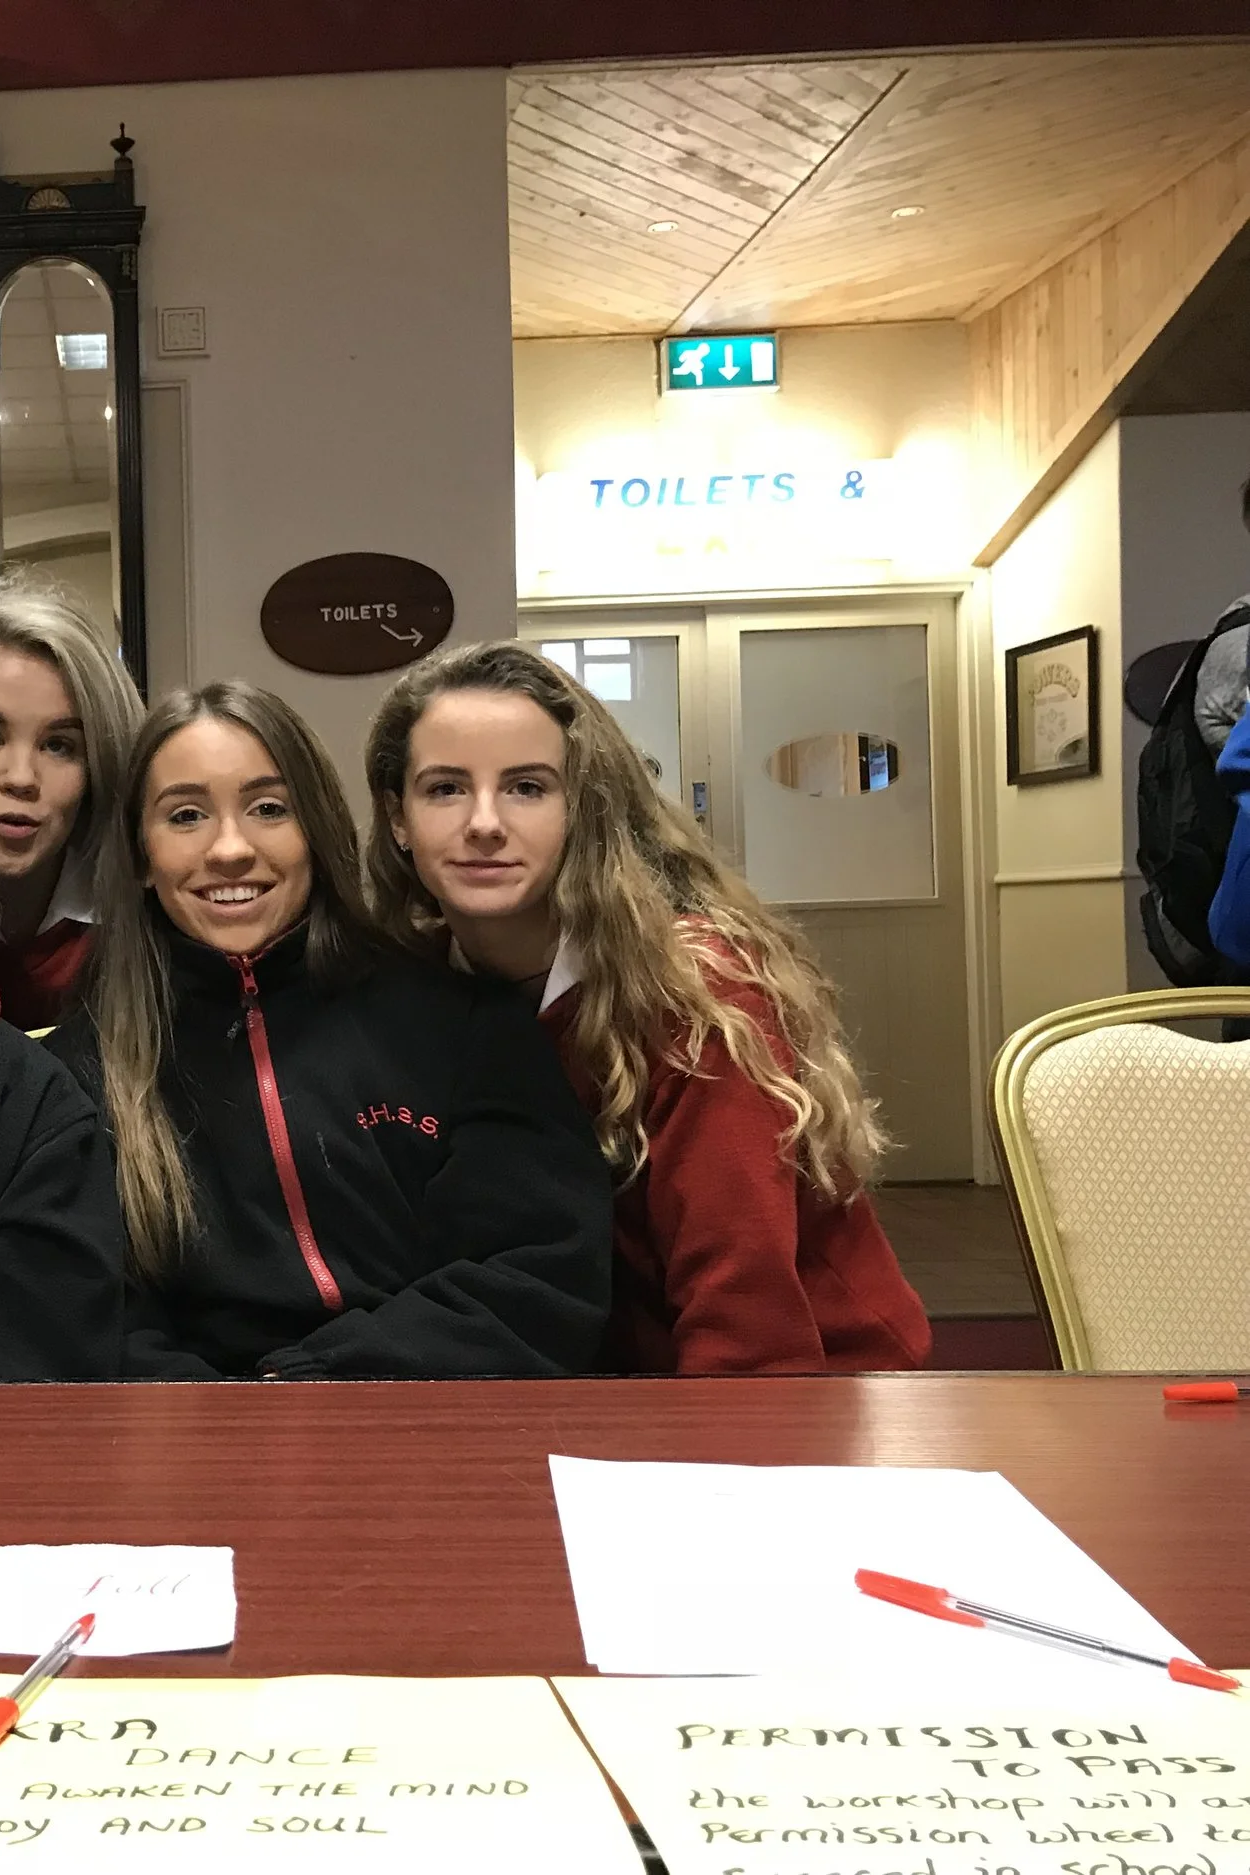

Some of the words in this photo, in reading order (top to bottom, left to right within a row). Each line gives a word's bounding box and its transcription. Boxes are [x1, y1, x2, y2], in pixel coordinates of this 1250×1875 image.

[590, 472, 796, 508] TOILETS
[839, 470, 866, 500] &
[320, 603, 398, 622] TOILETS
[675, 1723, 1149, 1750] PERMISSION
[125, 1746, 379, 1767] DANCE
[951, 1757, 1041, 1778] TO
[1064, 1755, 1237, 1777] PASS
[19, 1781, 233, 1800] AWAKEN
[258, 1781, 359, 1797] THE
[388, 1780, 530, 1797] MIND
[688, 1787, 769, 1809] the
[802, 1787, 1045, 1821] workshop
[1069, 1789, 1177, 1809] will
[99, 1817, 208, 1836] AND
[245, 1816, 389, 1834] SOUL
[700, 1821, 993, 1844] Permission
[1025, 1822, 1175, 1844] wheel
